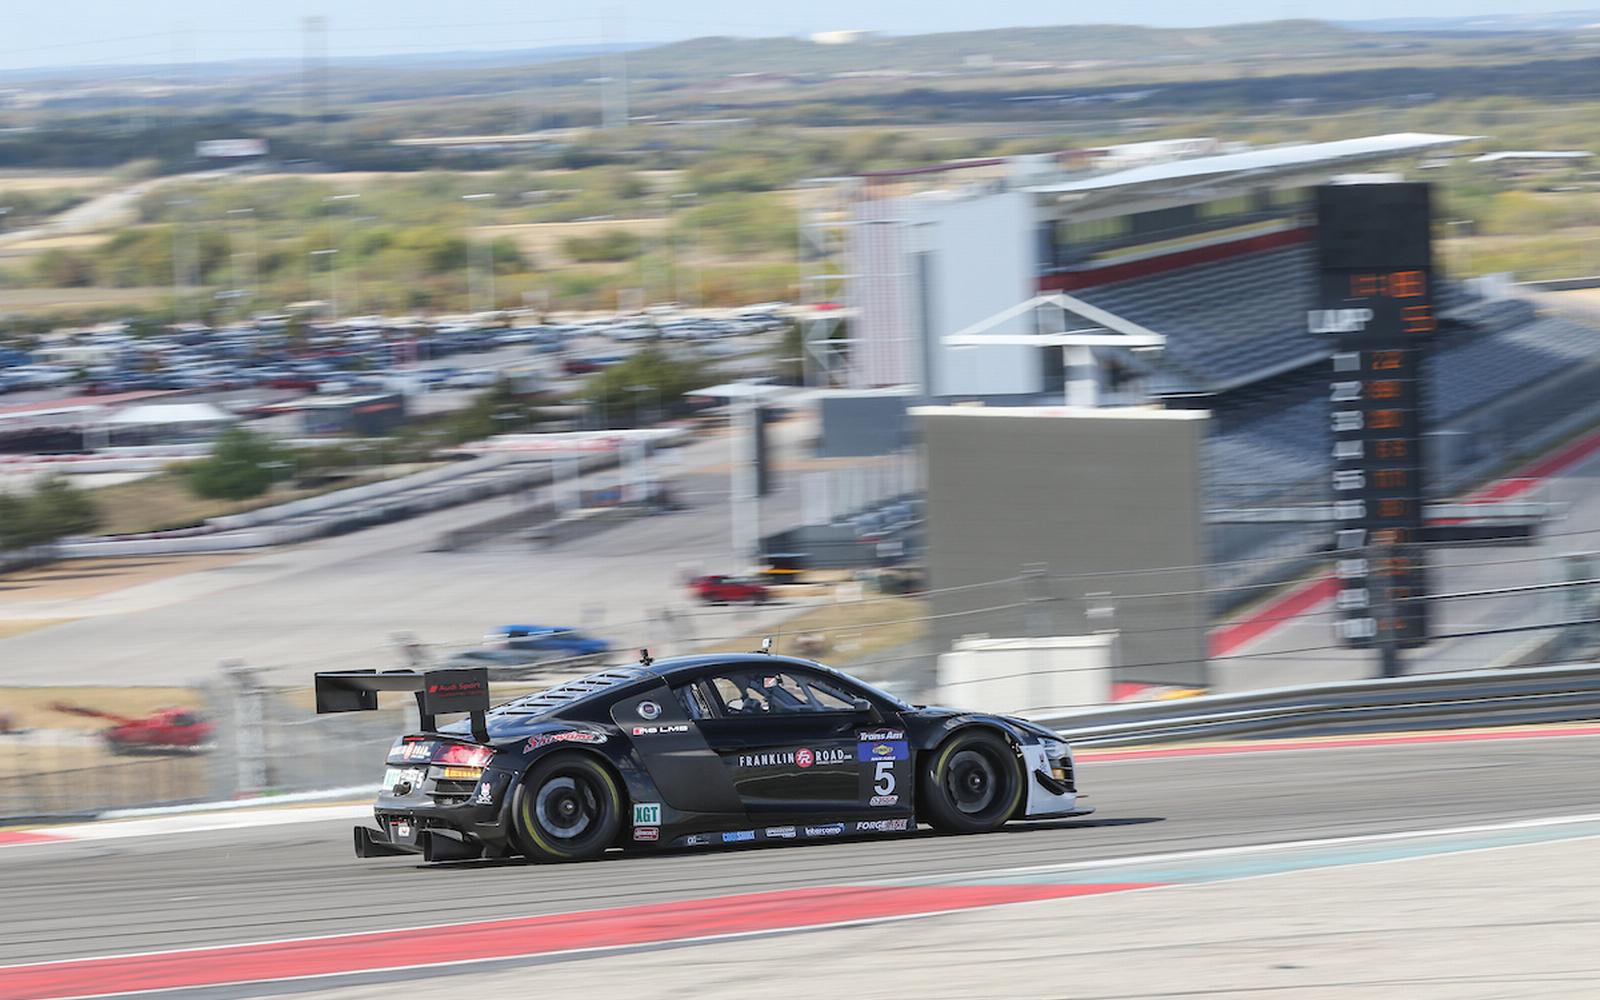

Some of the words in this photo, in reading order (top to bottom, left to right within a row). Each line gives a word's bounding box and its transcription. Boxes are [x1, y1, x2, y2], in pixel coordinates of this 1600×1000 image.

[860, 732, 886, 741] Trans
[886, 731, 903, 740] Am
[740, 752, 795, 767] FRANKLIN
[815, 749, 844, 762] ROAD
[874, 761, 896, 796] 5
[636, 806, 658, 823] XGT
